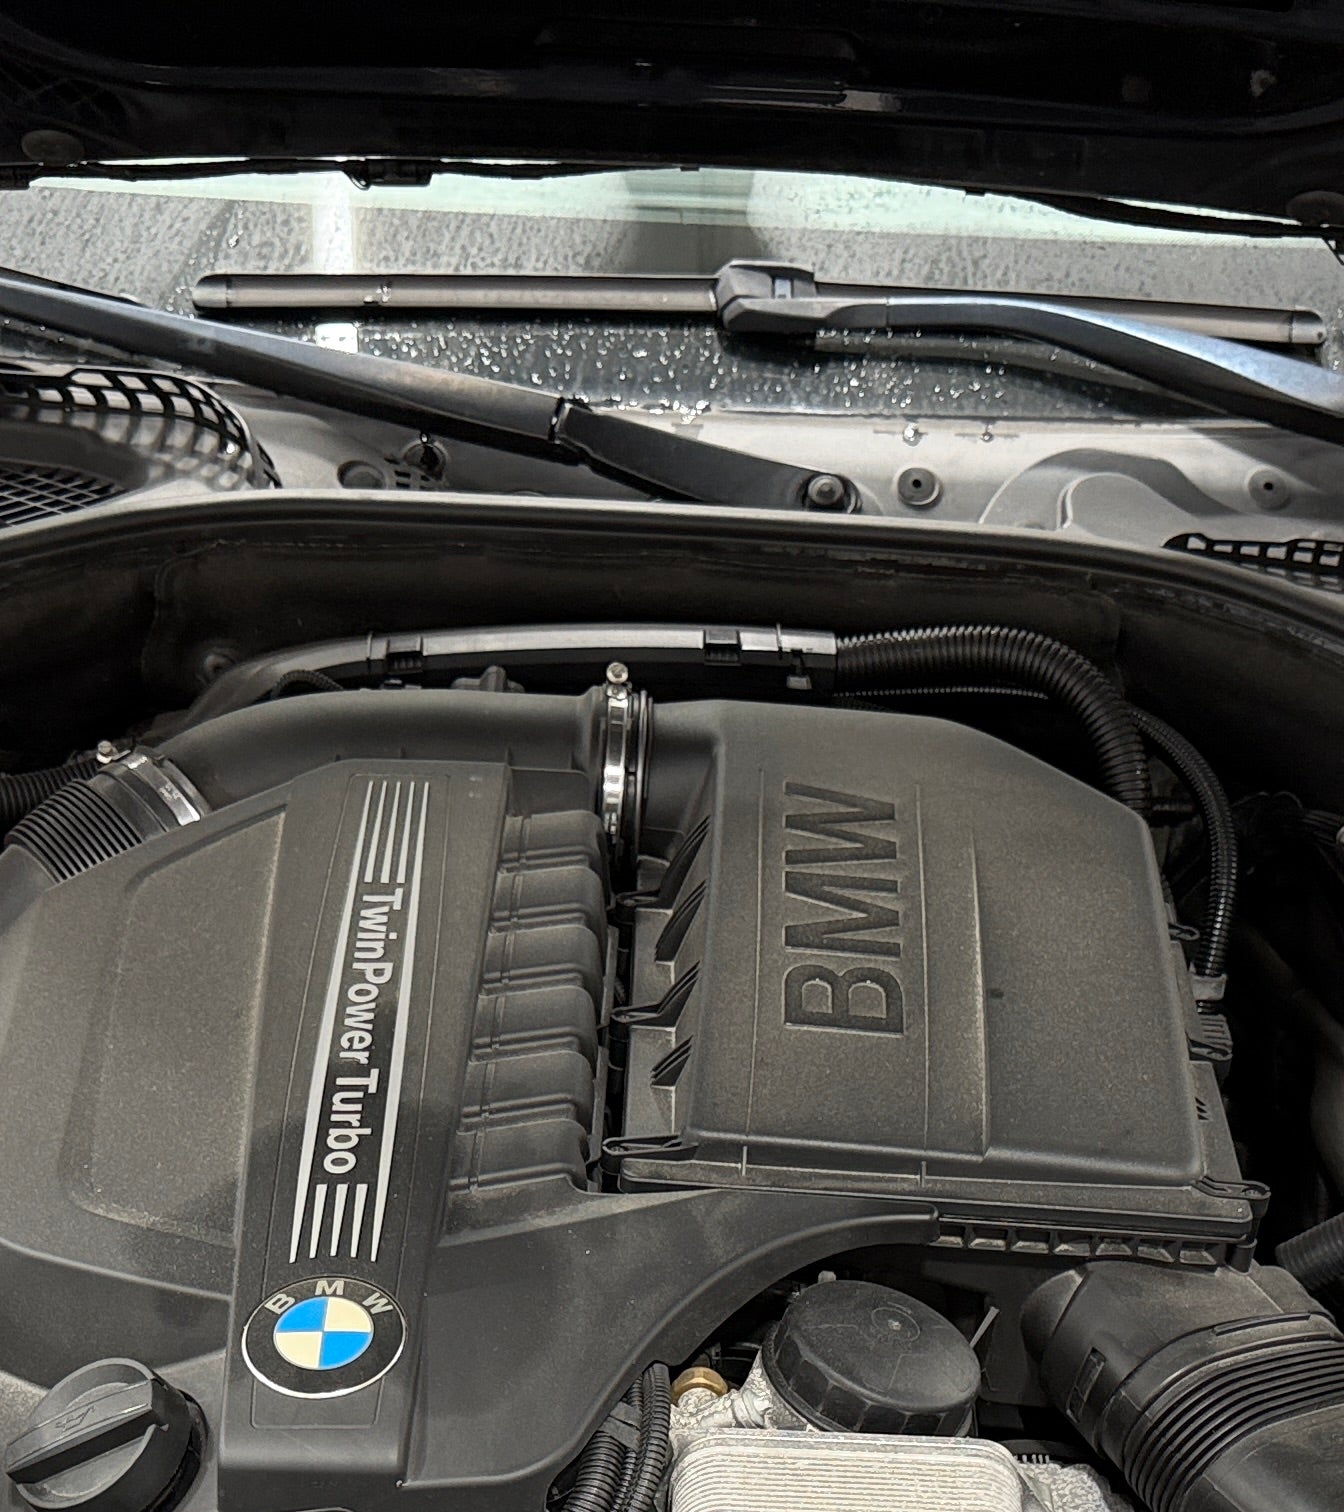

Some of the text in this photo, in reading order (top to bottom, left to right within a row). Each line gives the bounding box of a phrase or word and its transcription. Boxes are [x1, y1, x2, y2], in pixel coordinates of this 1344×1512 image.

[323, 887, 404, 1175] TwinPower Turbo
[782, 781, 905, 1037] BMW
[264, 1279, 394, 1315] BMW
